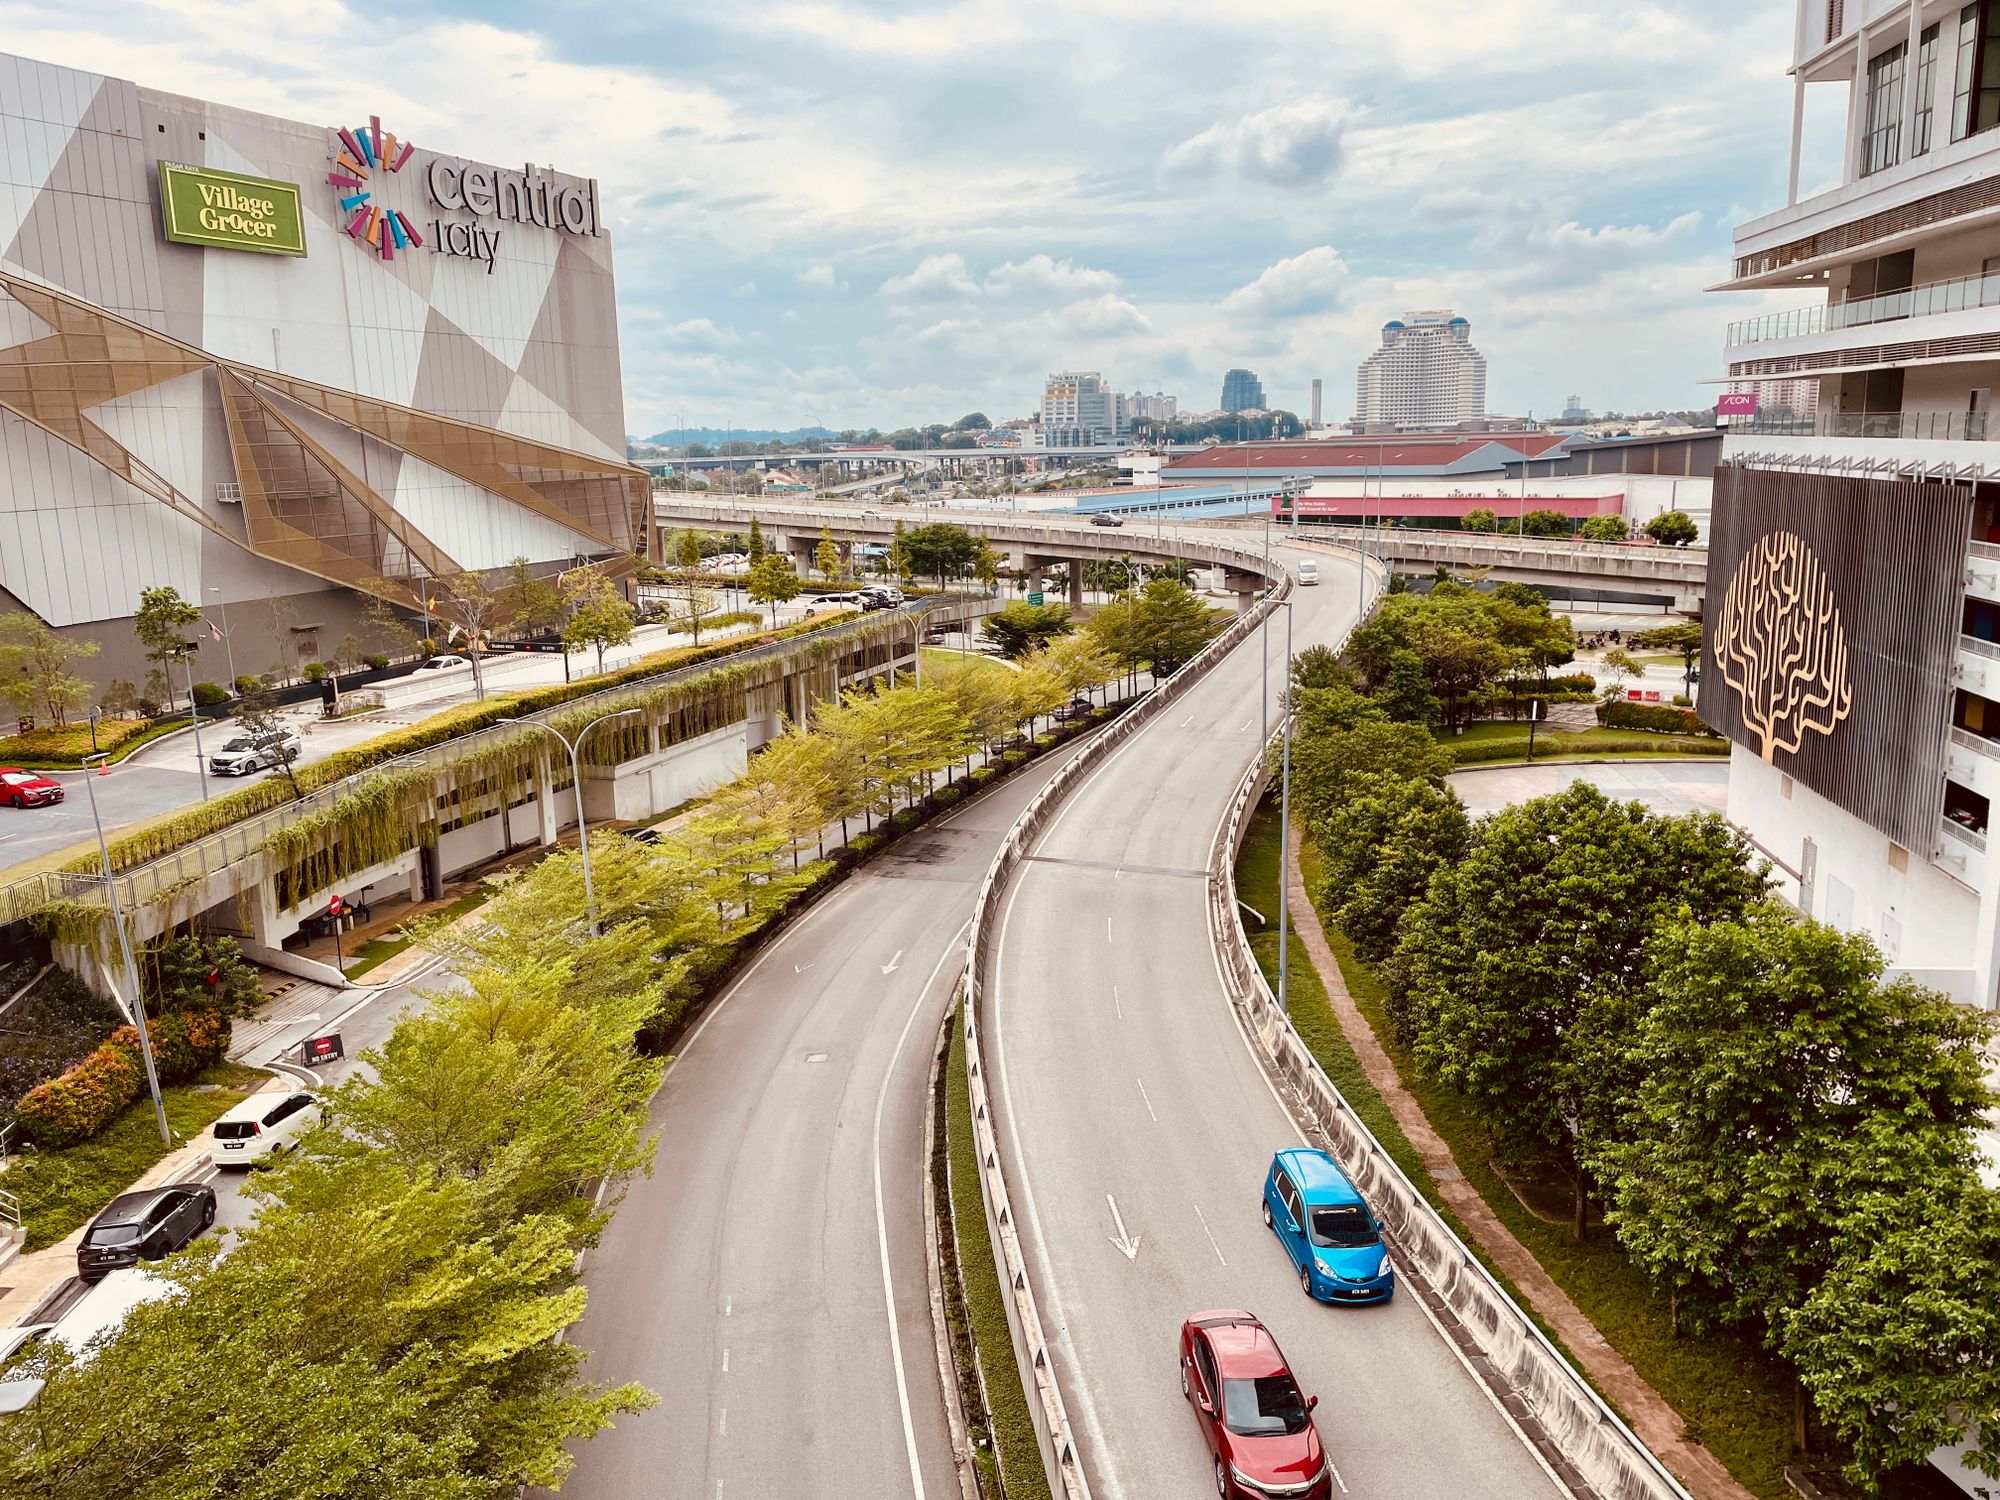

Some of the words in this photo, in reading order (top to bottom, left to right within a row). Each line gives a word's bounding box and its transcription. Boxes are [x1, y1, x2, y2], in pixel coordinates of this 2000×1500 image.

[197, 183, 274, 220] Village
[428, 156, 601, 237] central
[199, 207, 277, 238] Grocer
[320, 1051, 338, 1060] ENTRY
